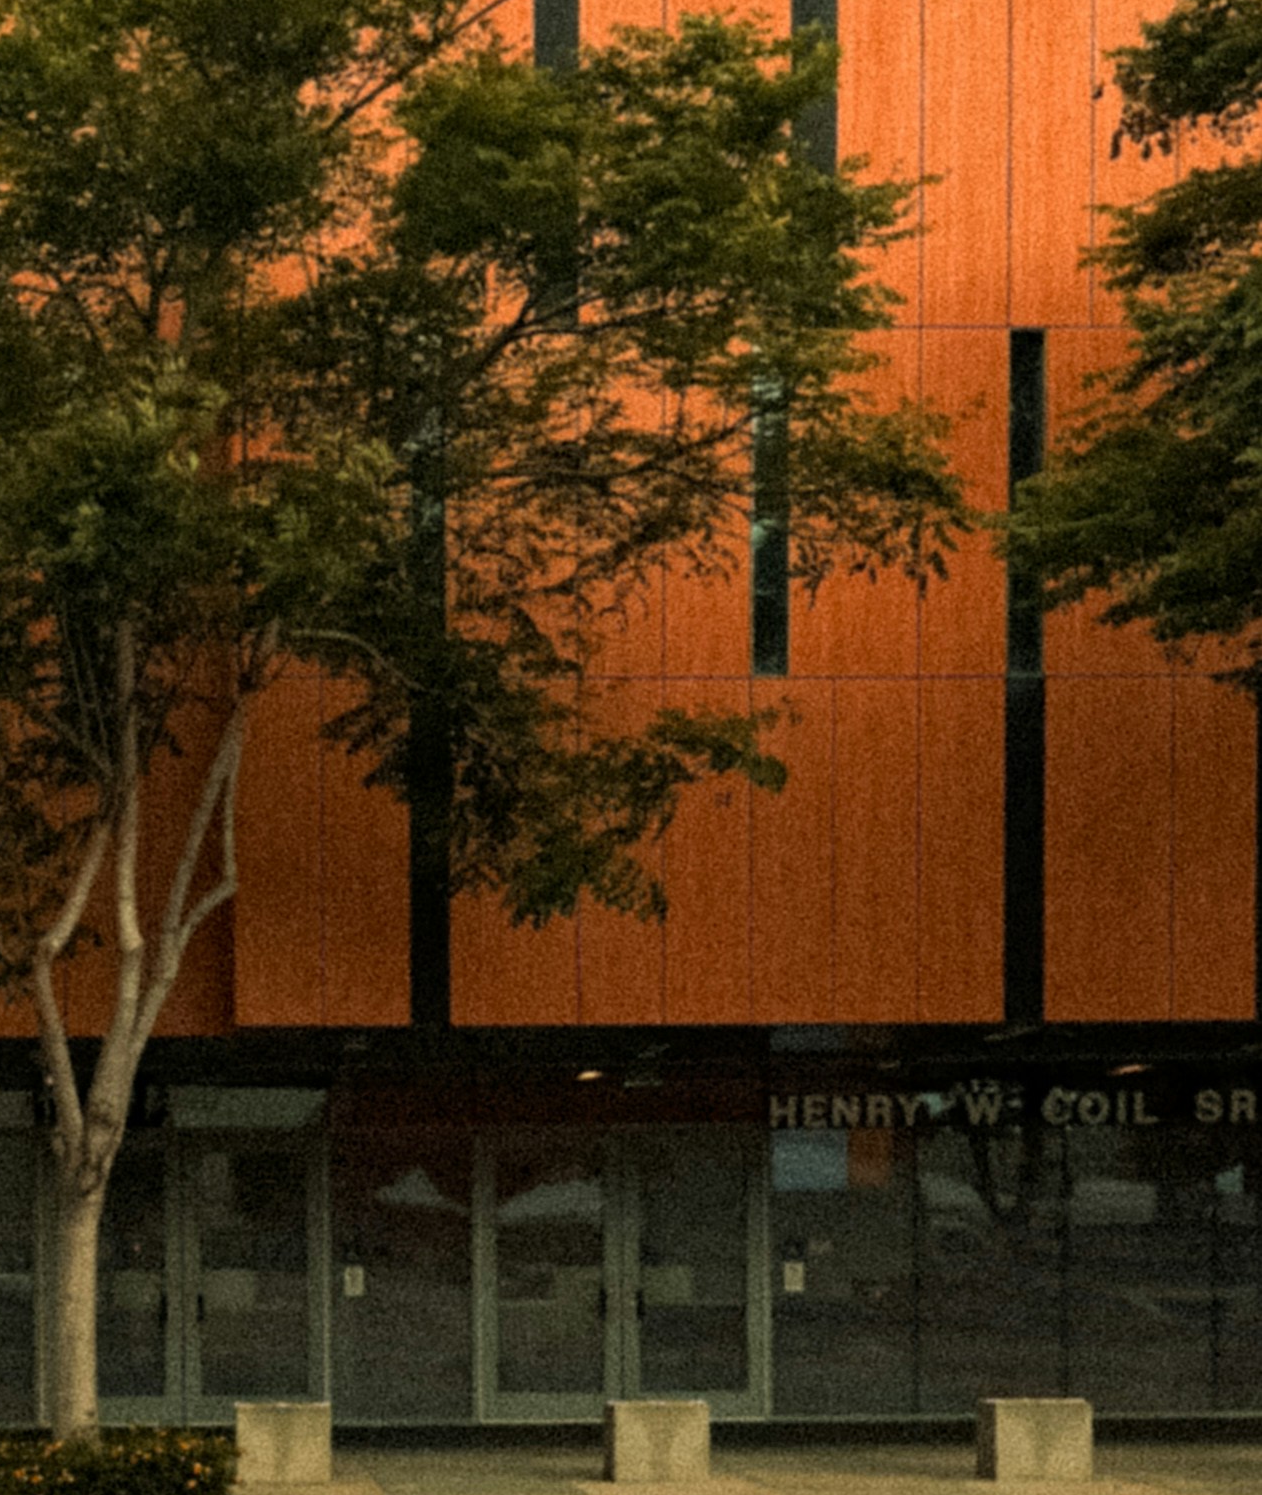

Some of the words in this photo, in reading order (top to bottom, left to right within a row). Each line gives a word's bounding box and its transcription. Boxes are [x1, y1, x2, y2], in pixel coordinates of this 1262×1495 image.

[767, 1094, 920, 1127] HENRY
[1040, 1088, 1161, 1125] COIL
[1194, 1087, 1258, 1123] SR
